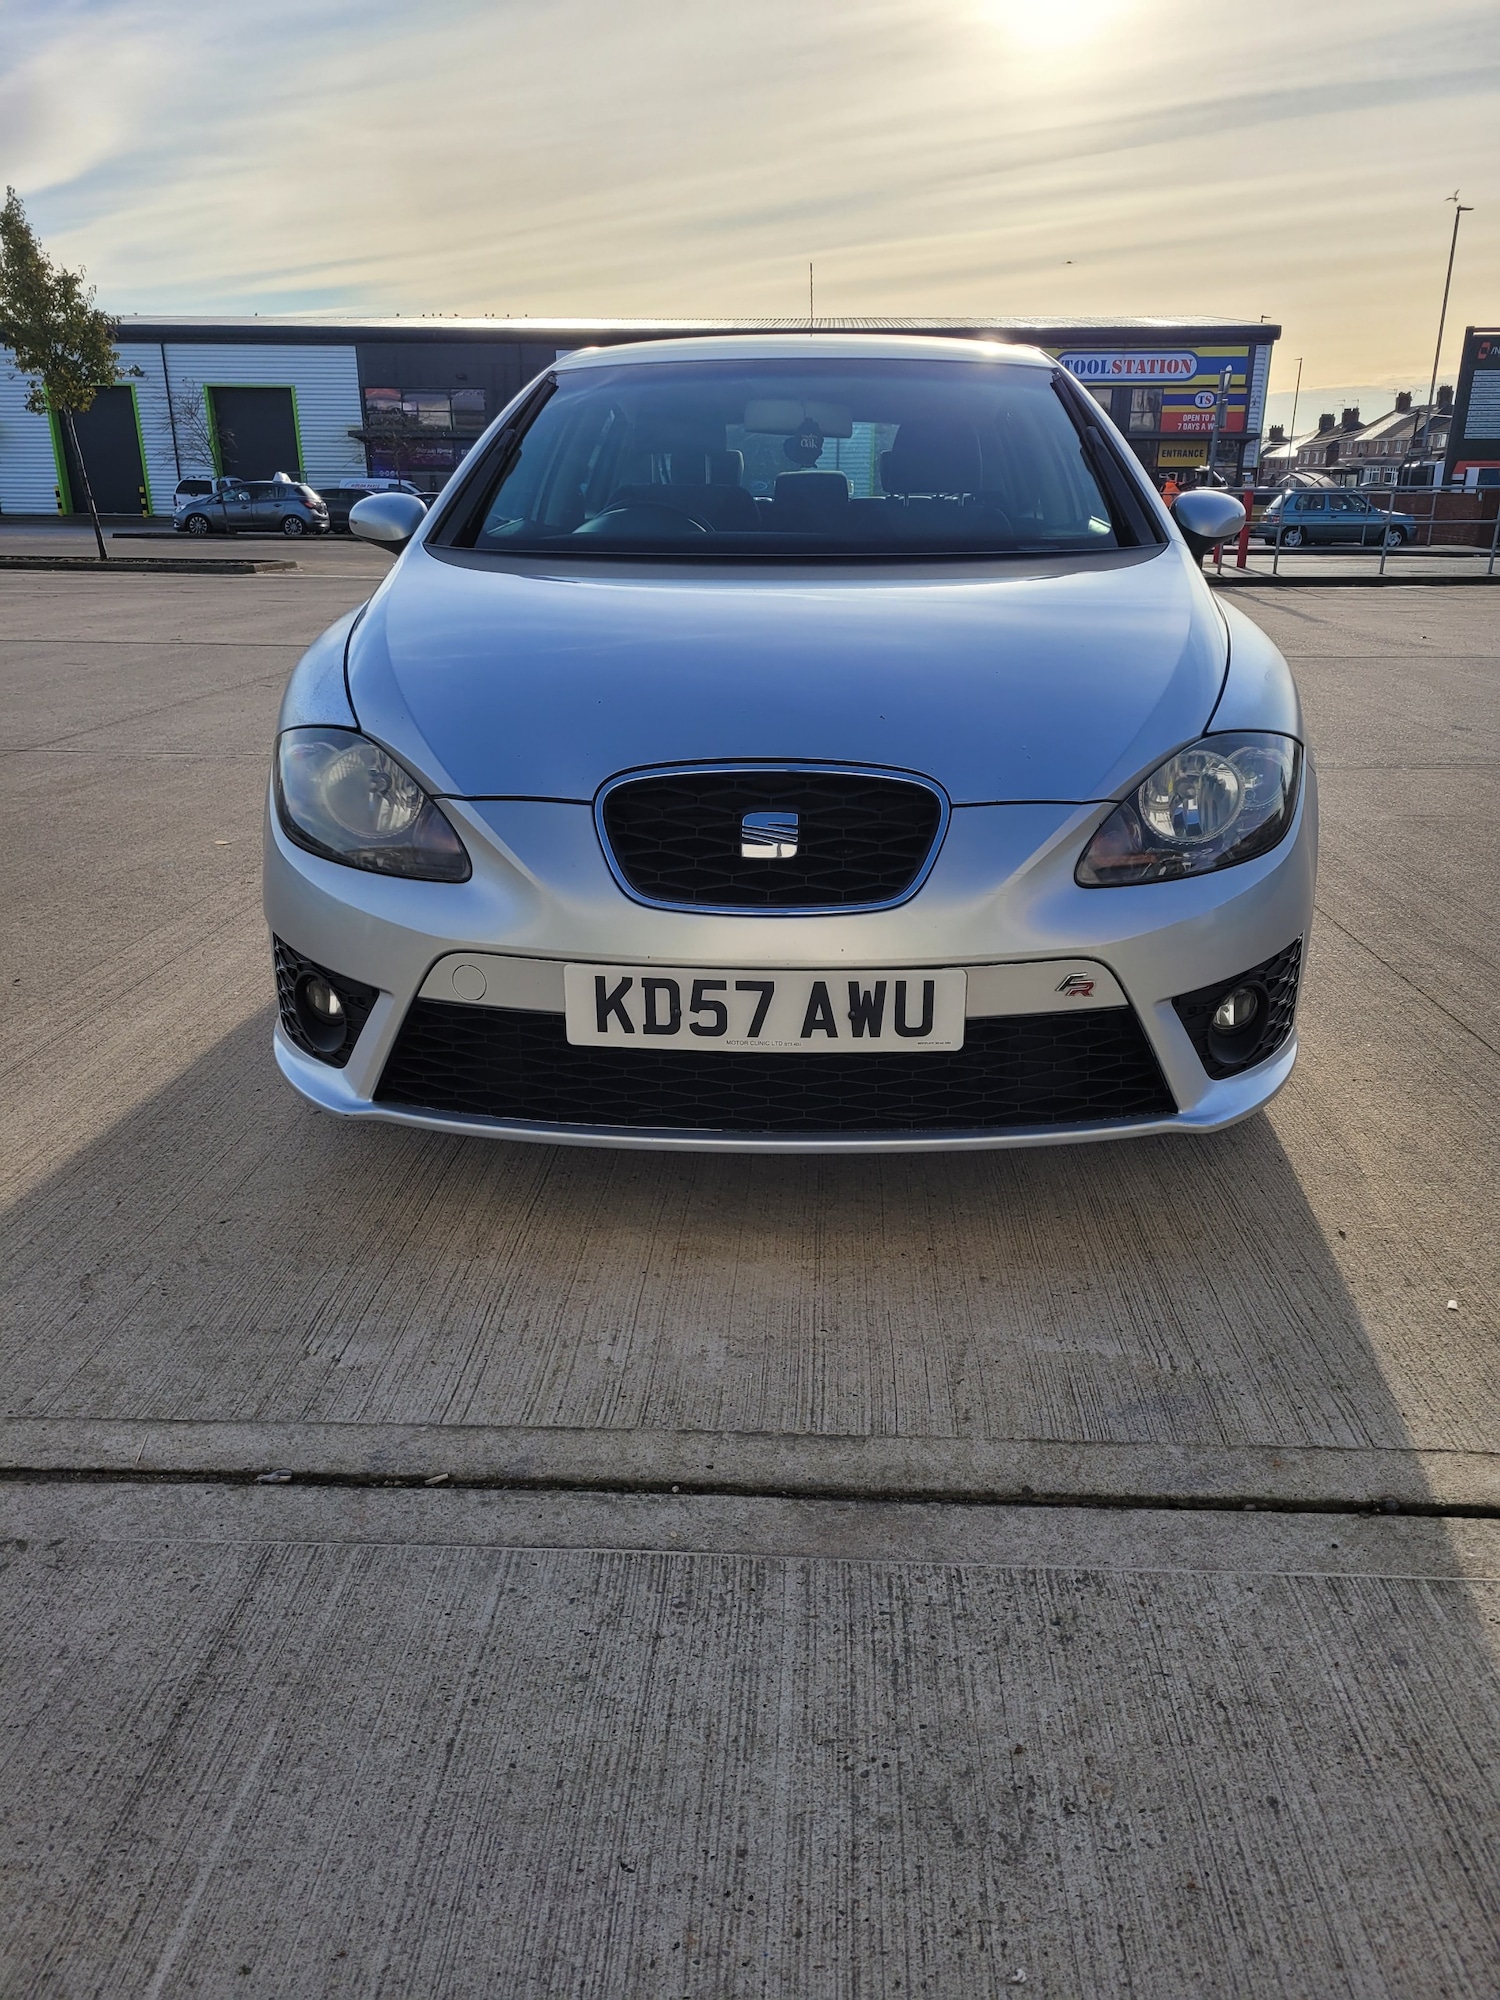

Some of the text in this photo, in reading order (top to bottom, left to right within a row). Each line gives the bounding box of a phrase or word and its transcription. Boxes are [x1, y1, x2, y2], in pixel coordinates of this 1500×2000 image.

[1062, 359, 1194, 374] TOOLSTATION
[1197, 395, 1212, 404] TS
[1182, 414, 1200, 422] OPEN
[1201, 414, 1210, 422] TO
[1177, 423, 1182, 431] 7
[1182, 423, 1200, 431] DAYS
[1201, 423, 1206, 431] A
[1161, 449, 1204, 458] ENTRANCE
[1055, 971, 1095, 997] FR
[594, 975, 935, 1039] KD57 AWU
